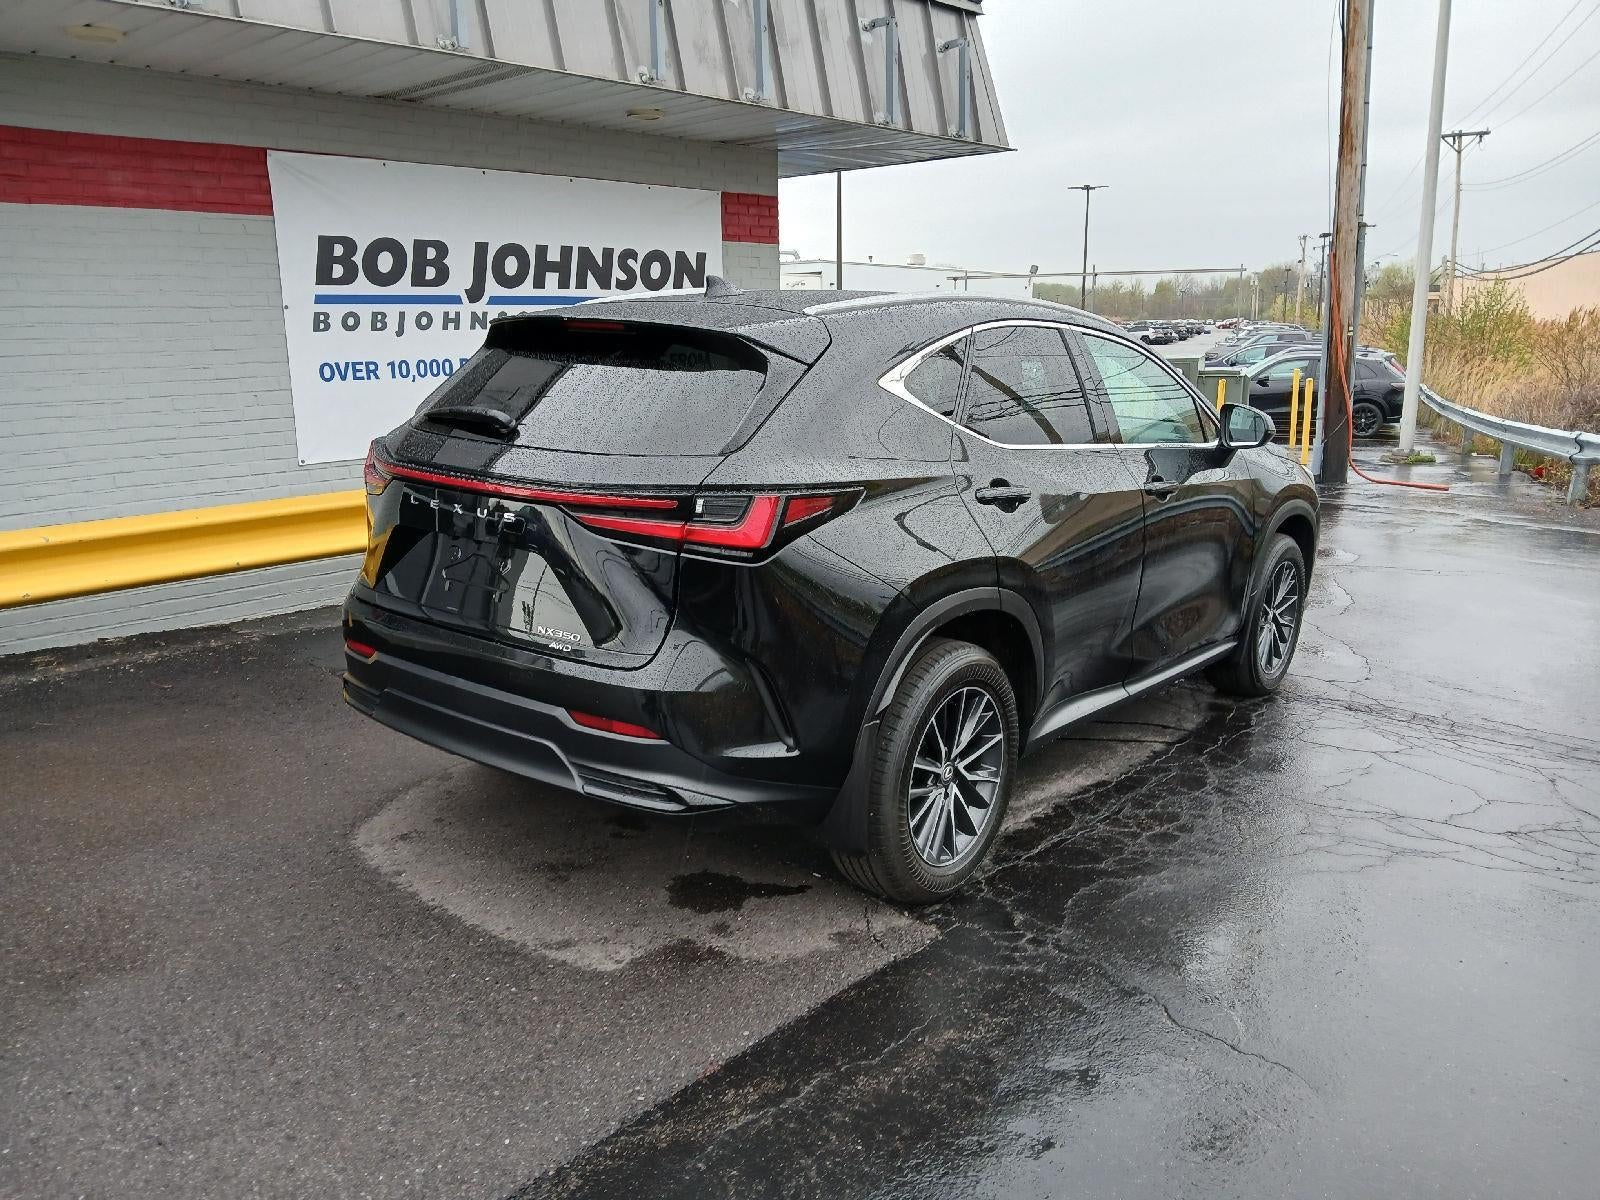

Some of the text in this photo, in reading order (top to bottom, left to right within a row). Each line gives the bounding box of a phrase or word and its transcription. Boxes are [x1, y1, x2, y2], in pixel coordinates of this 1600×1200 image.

[315, 235, 707, 303] BOB JOHNSON
[312, 311, 527, 338] BOBJOHN
[318, 361, 381, 382] OVER
[386, 358, 454, 382] 10,000
[410, 494, 516, 523] LEXUS
[537, 625, 581, 642] NX350
[548, 641, 572, 652] AWD
